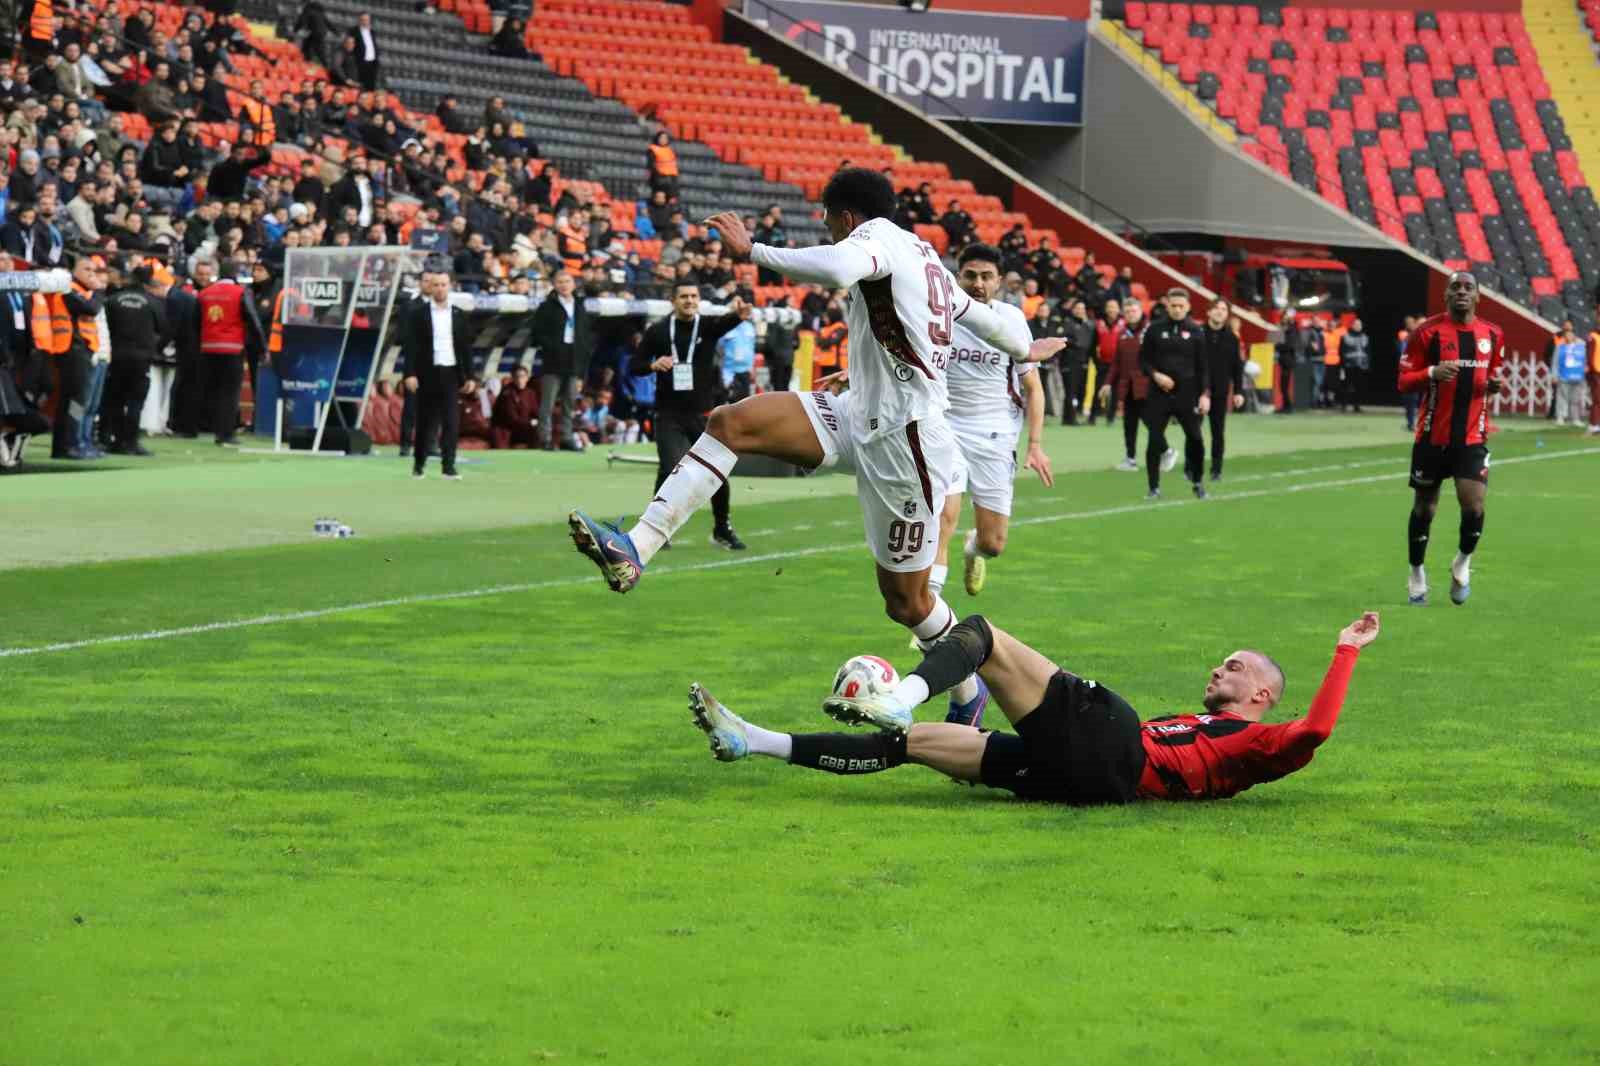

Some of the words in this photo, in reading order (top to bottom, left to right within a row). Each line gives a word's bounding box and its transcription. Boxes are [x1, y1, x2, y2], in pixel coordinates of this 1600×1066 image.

[869, 29, 1004, 55] INTERNATIONAL
[868, 48, 1077, 104] HOSPITAL
[307, 283, 337, 298] VAR
[949, 347, 1000, 365] apara
[888, 521, 924, 553] 99
